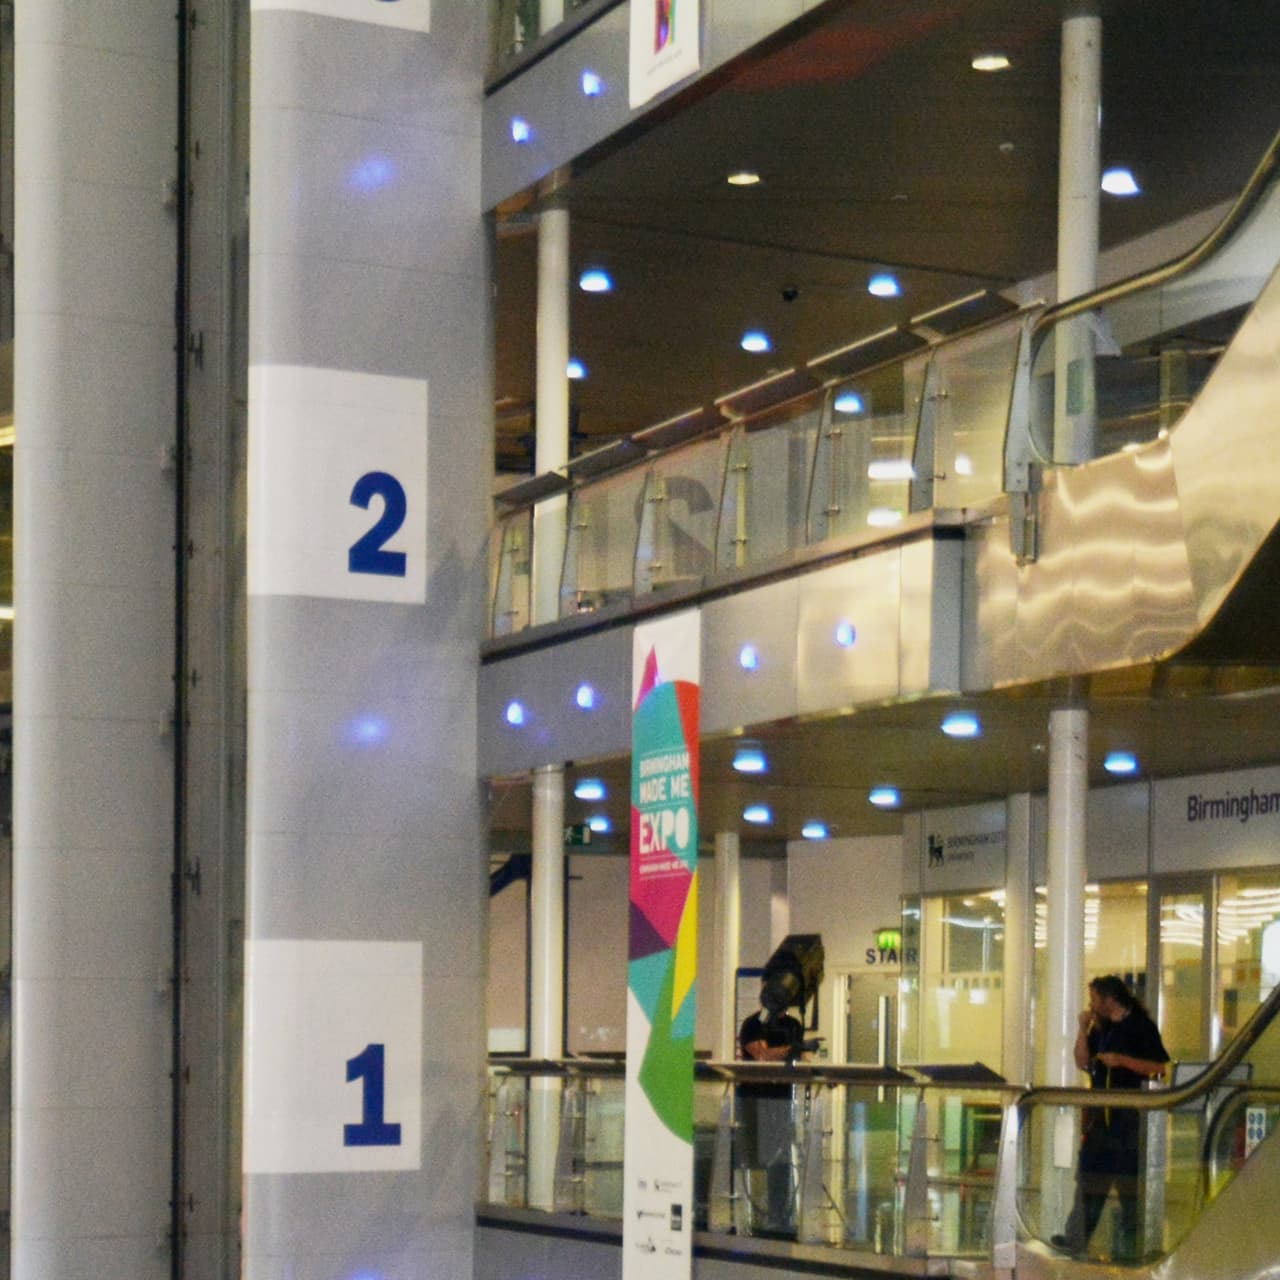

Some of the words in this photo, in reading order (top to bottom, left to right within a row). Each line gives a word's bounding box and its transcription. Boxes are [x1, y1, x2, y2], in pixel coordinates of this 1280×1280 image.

[348, 471, 407, 577] 2
[640, 777, 667, 804] MADE
[670, 771, 690, 799] ME
[1187, 786, 1280, 823] Birmingham
[639, 806, 690, 854] EXPO
[343, 1042, 402, 1147] 1
